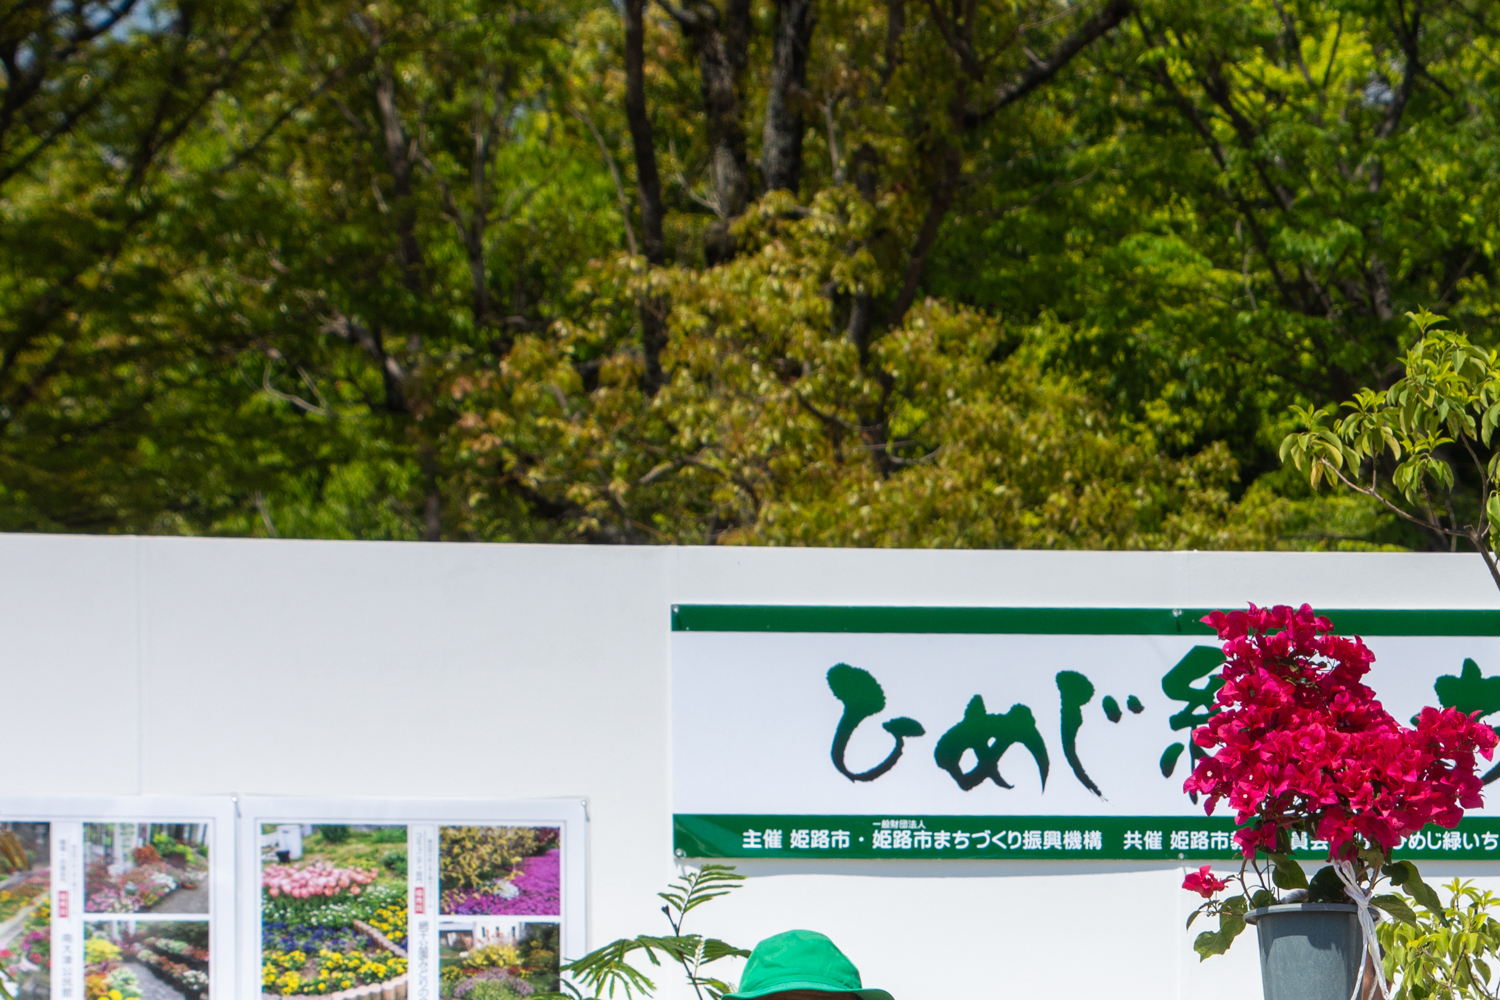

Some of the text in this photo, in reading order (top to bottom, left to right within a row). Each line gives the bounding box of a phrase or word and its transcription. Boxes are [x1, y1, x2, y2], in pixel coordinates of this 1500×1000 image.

[872, 820, 926, 829] 一般財団法人
[742, 829, 783, 849] 主催
[1123, 830, 1163, 850] 共催
